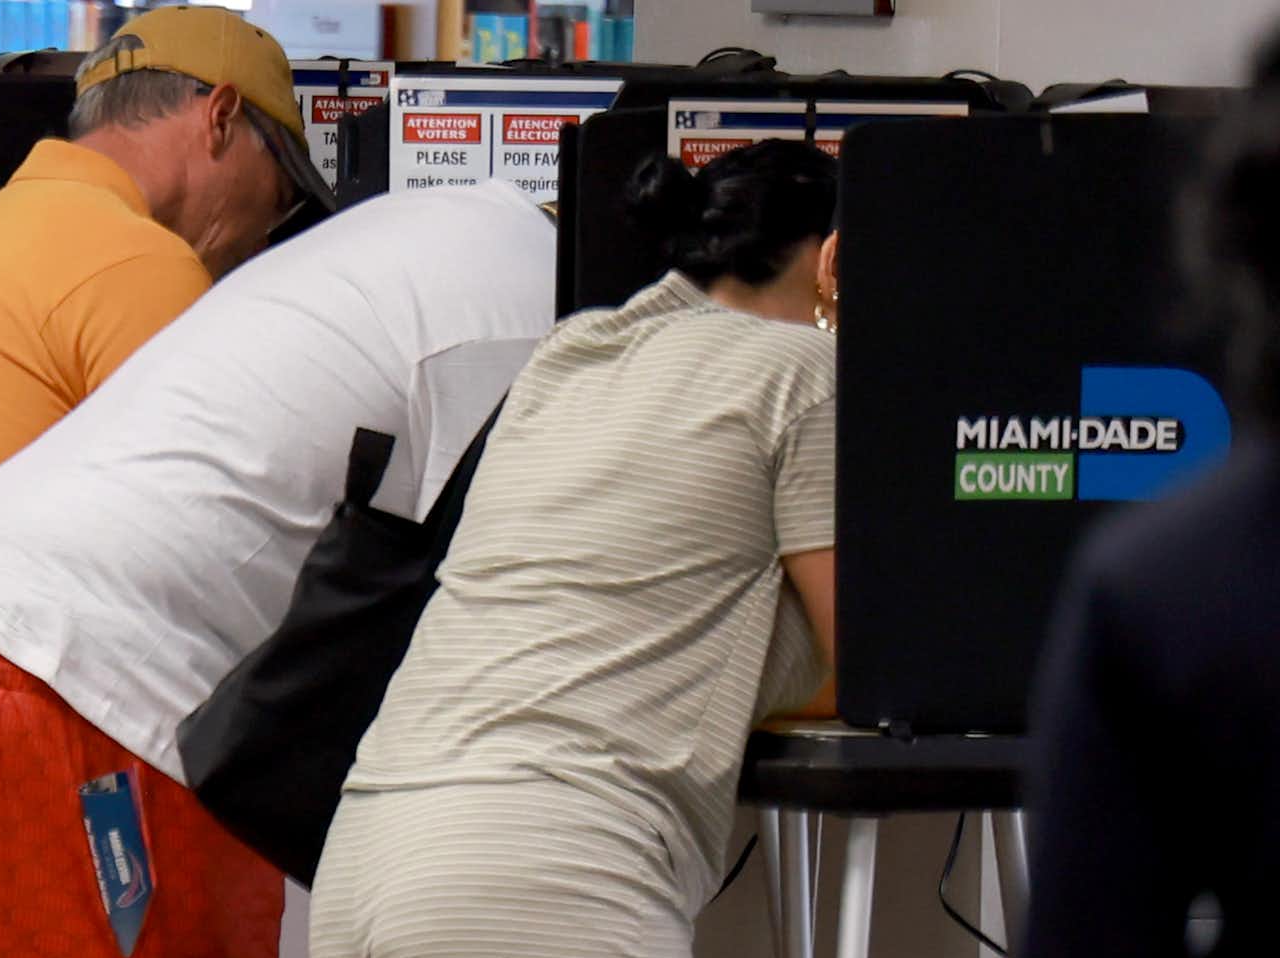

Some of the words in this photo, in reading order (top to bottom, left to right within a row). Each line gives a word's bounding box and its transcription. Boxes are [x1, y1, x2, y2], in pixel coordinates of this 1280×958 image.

[407, 118, 477, 129] ATTENTION
[416, 129, 467, 139] VOTERS
[416, 151, 468, 166] PLEASE
[504, 152, 530, 167] POR
[534, 152, 560, 167] FAV
[406, 175, 444, 189] make
[959, 463, 1069, 493] COUNTY
